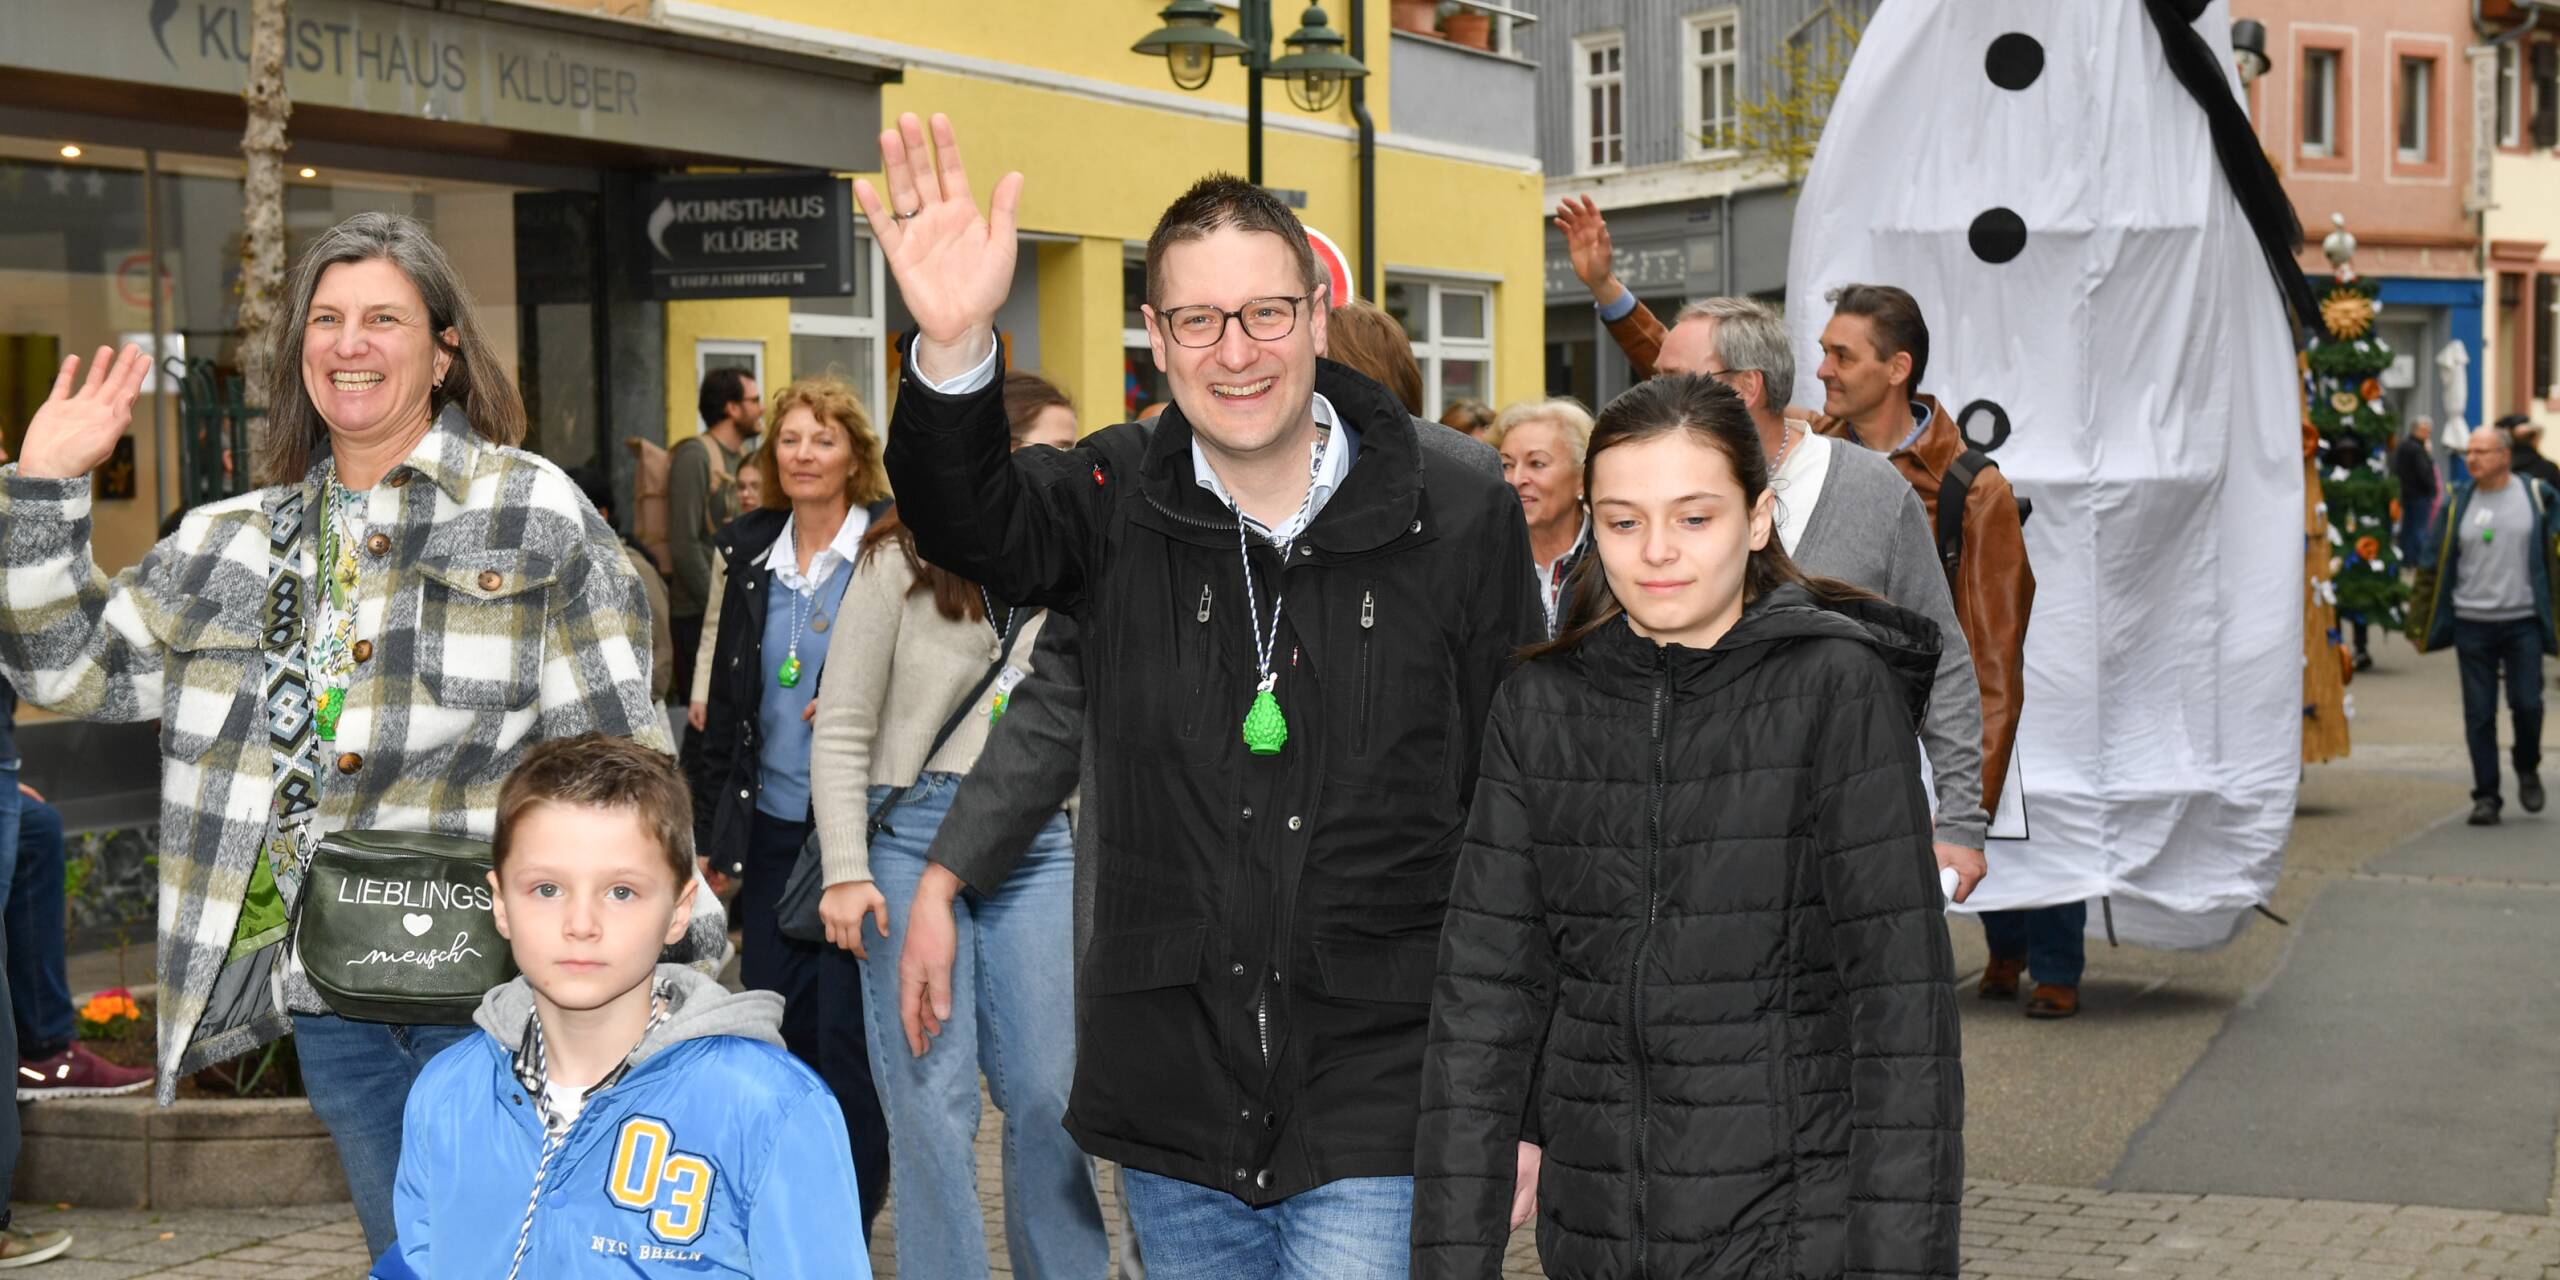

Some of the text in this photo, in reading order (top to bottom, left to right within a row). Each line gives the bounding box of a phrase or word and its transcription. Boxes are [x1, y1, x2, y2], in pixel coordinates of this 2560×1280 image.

[499, 50, 640, 116] KLÜBER
[676, 195, 825, 223] KUNSTHAUS
[703, 226, 800, 253] KLÜBER
[338, 877, 493, 911] LIEBLINGS
[606, 1115, 715, 1244] 03
[591, 1235, 629, 1256] NYC
